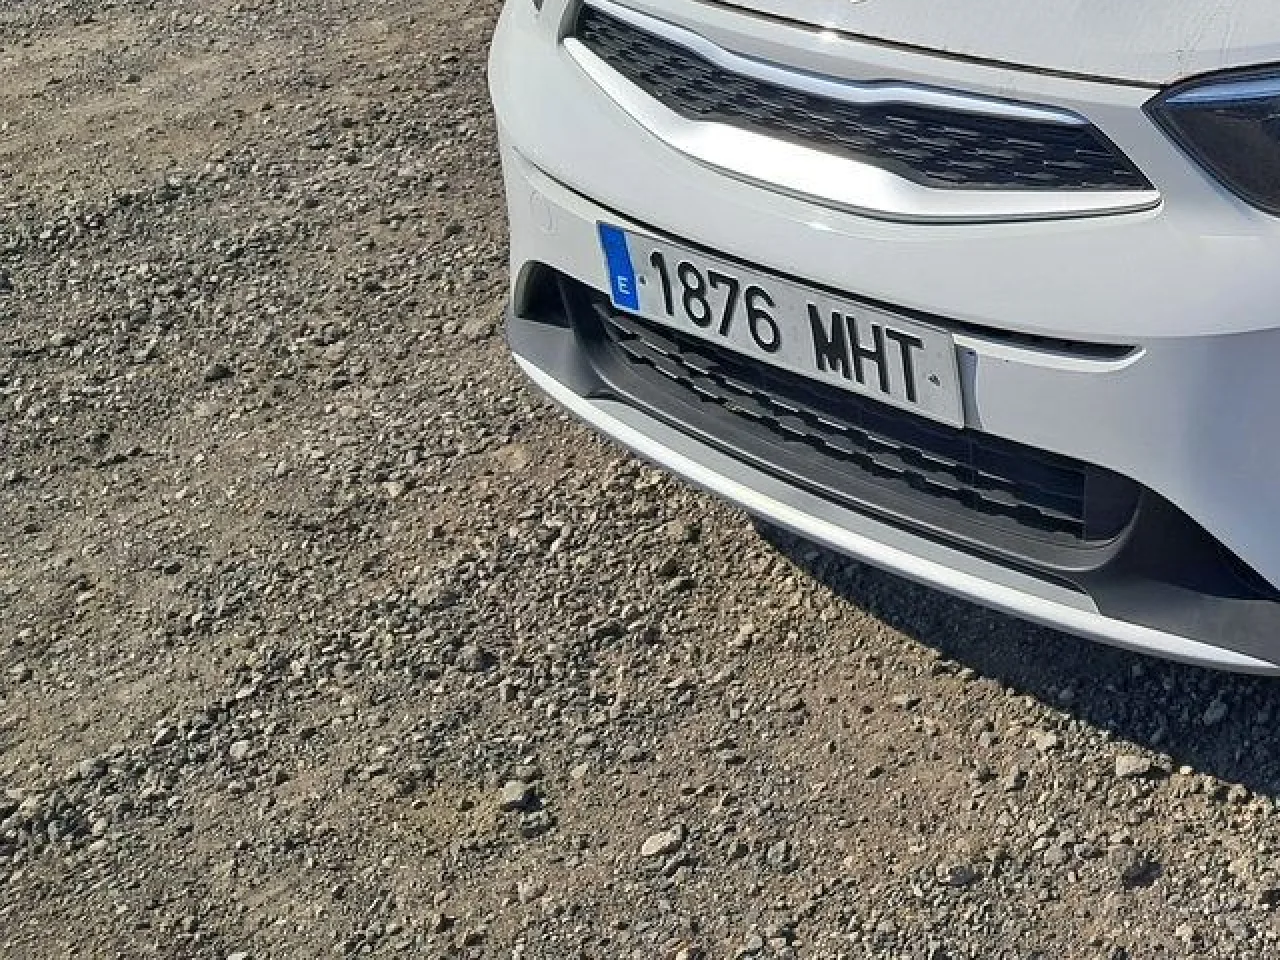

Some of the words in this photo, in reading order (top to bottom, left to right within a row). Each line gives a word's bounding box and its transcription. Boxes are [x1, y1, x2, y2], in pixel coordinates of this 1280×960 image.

[617, 276, 630, 294] E
[650, 251, 780, 353] 1876
[807, 303, 923, 402] MHT
